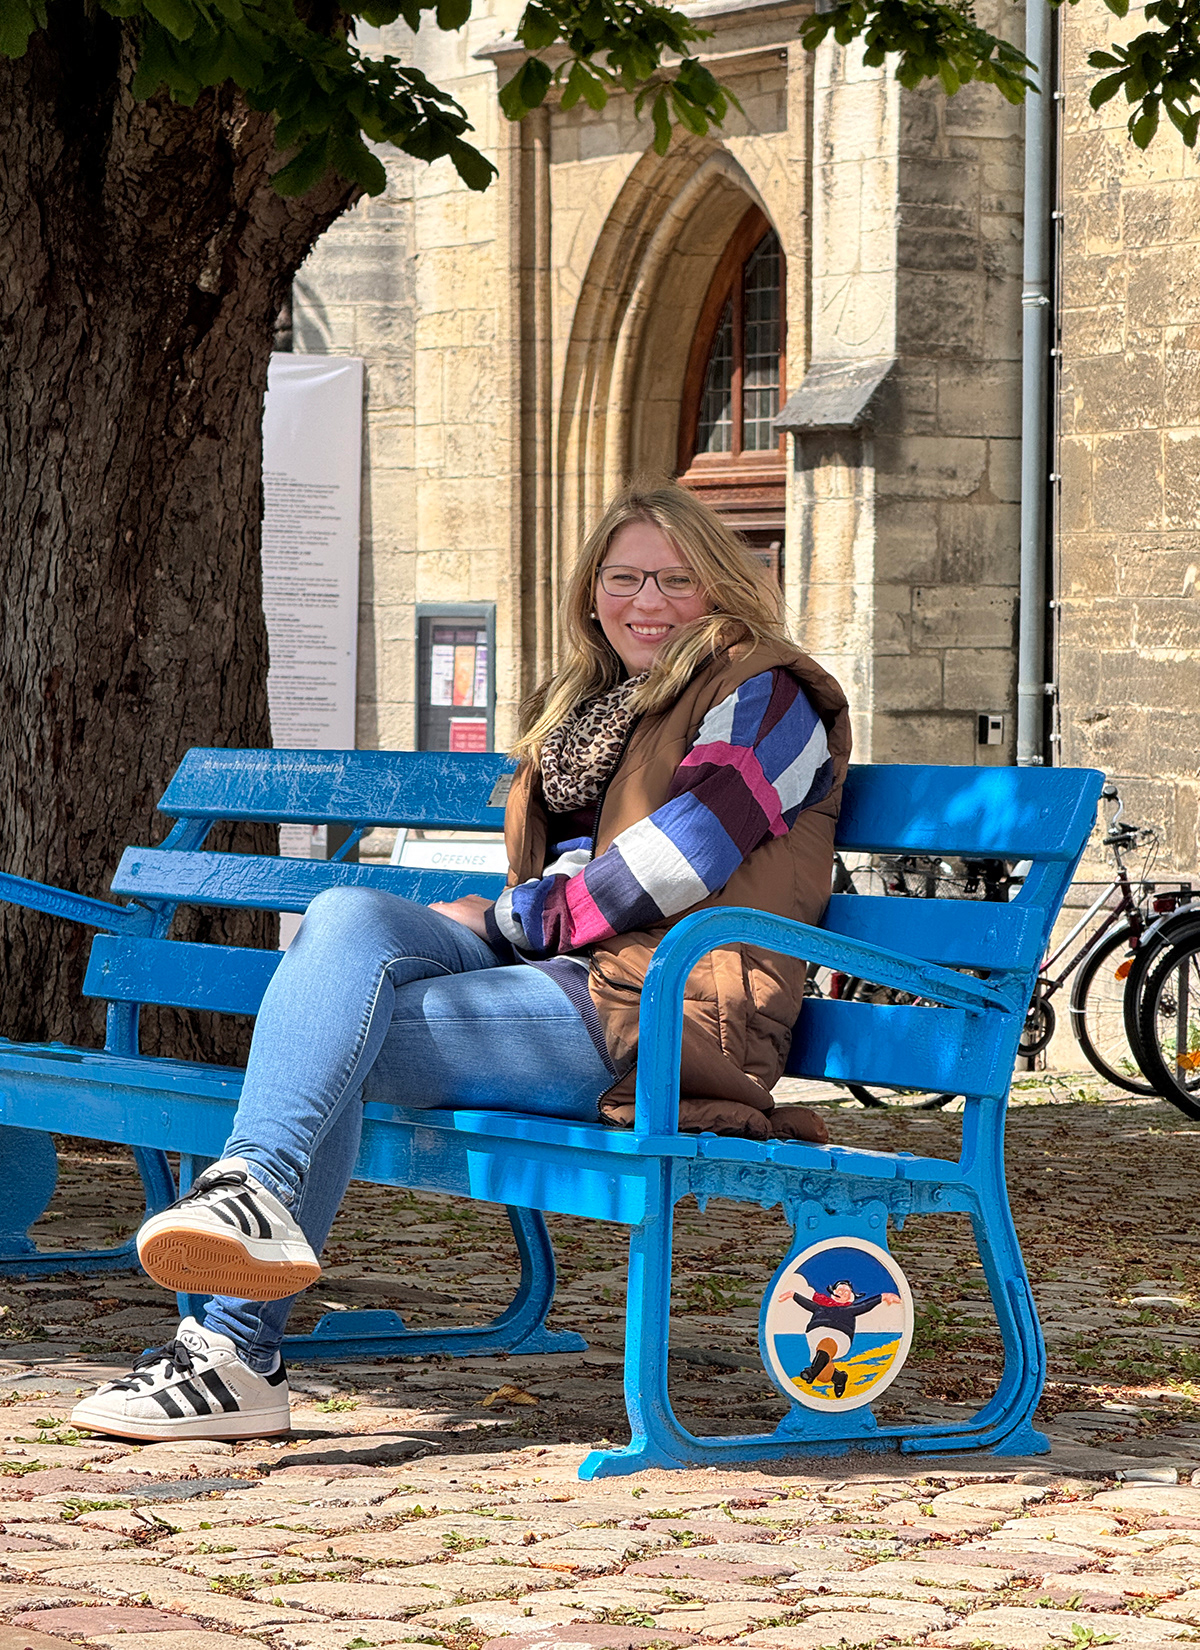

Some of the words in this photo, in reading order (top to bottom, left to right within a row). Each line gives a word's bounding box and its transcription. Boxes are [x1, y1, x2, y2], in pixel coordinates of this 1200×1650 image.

[431, 852, 487, 866] OFFENES
[738, 915, 804, 949] TAYLOR
[225, 1379, 241, 1398] CAMPUS
